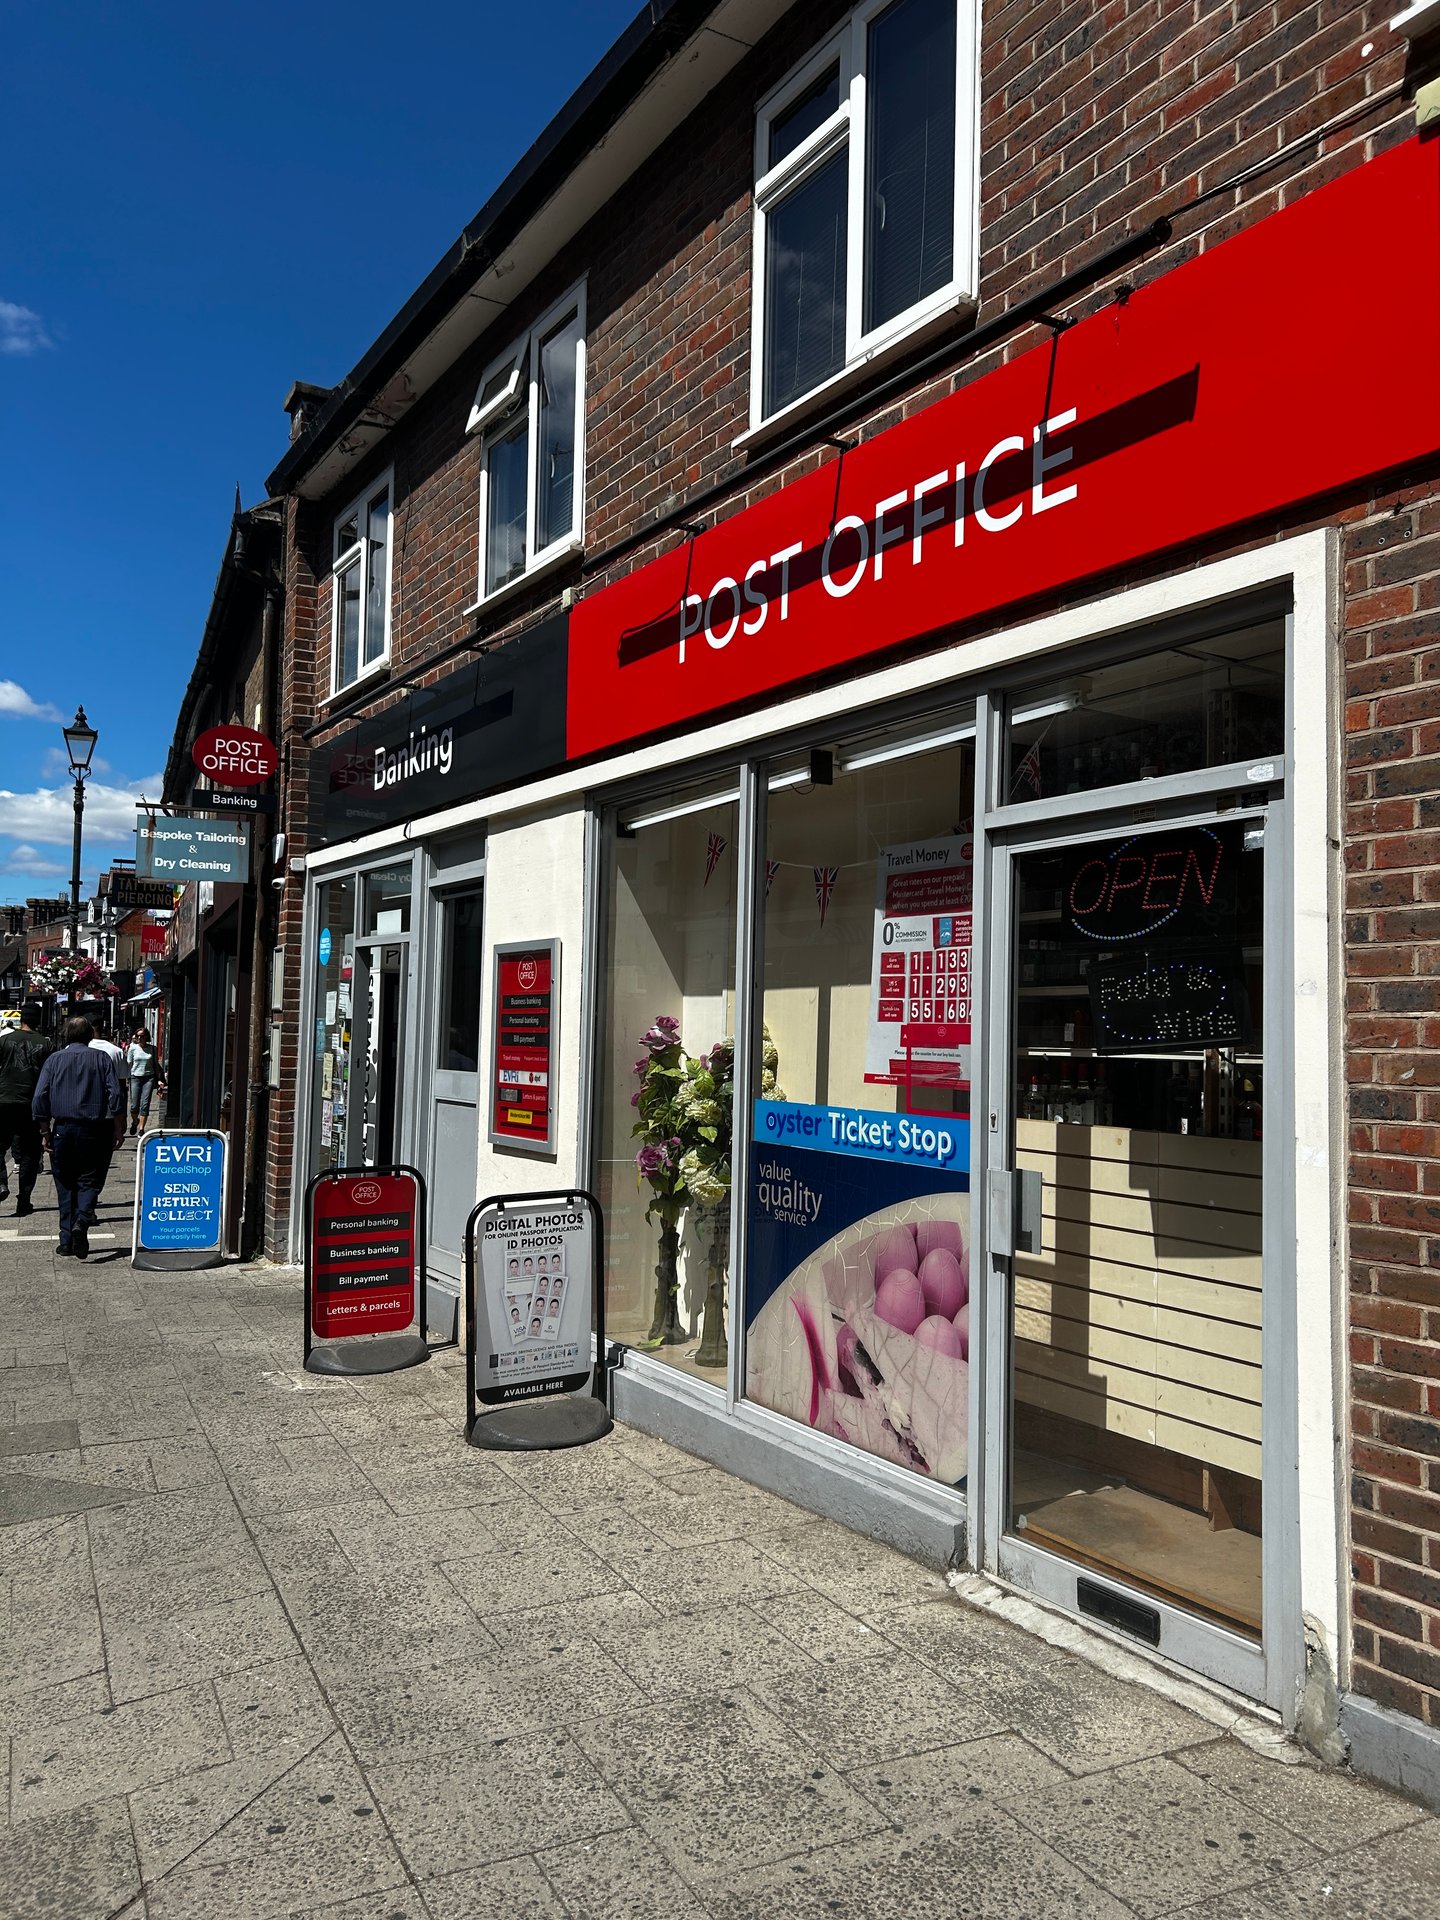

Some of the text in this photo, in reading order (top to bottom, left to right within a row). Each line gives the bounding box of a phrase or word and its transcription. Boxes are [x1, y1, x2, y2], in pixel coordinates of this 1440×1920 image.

[678, 407, 1078, 664] POST OFFICE
[216, 738, 262, 756] POST
[203, 754, 268, 774] OFFICE
[374, 725, 453, 791] Banking
[212, 794, 257, 808] Banking
[140, 828, 246, 845] Bespoke Tailoring
[188, 844, 198, 853] &
[886, 852, 914, 866] Travel
[916, 848, 950, 863] Money
[154, 858, 230, 872] Dry Cleaning
[943, 871, 965, 884] prepaid
[1070, 850, 1222, 914] OPEN
[927, 886, 944, 896] Travel
[945, 885, 965, 894] Money
[118, 892, 172, 906] PIERCING
[892, 900, 908, 909] when
[910, 902, 919, 910] you
[920, 899, 937, 909] spend
[946, 896, 958, 904] least
[520, 971, 534, 980] OFFICE
[1101, 968, 1170, 1003] Food
[766, 1110, 952, 1160] oyster Ticket Stop
[156, 1146, 212, 1162] EVRi
[155, 1166, 211, 1176] ParcelShop
[760, 1160, 791, 1182] value
[164, 1184, 200, 1193] SEND
[152, 1197, 210, 1207] RETURN
[758, 1181, 822, 1222] quality
[148, 1210, 213, 1221] COLLECT
[486, 1213, 584, 1232] DIGITAL PHOTOS
[774, 1208, 807, 1226] service
[331, 1218, 398, 1230] Personal banking
[507, 1235, 563, 1249] ID PHOTOS
[330, 1246, 399, 1258] Business banking
[354, 1274, 388, 1284] payment
[327, 1300, 400, 1315] Letters & parcels
[504, 1381, 563, 1397] AVAILABLE HERE
